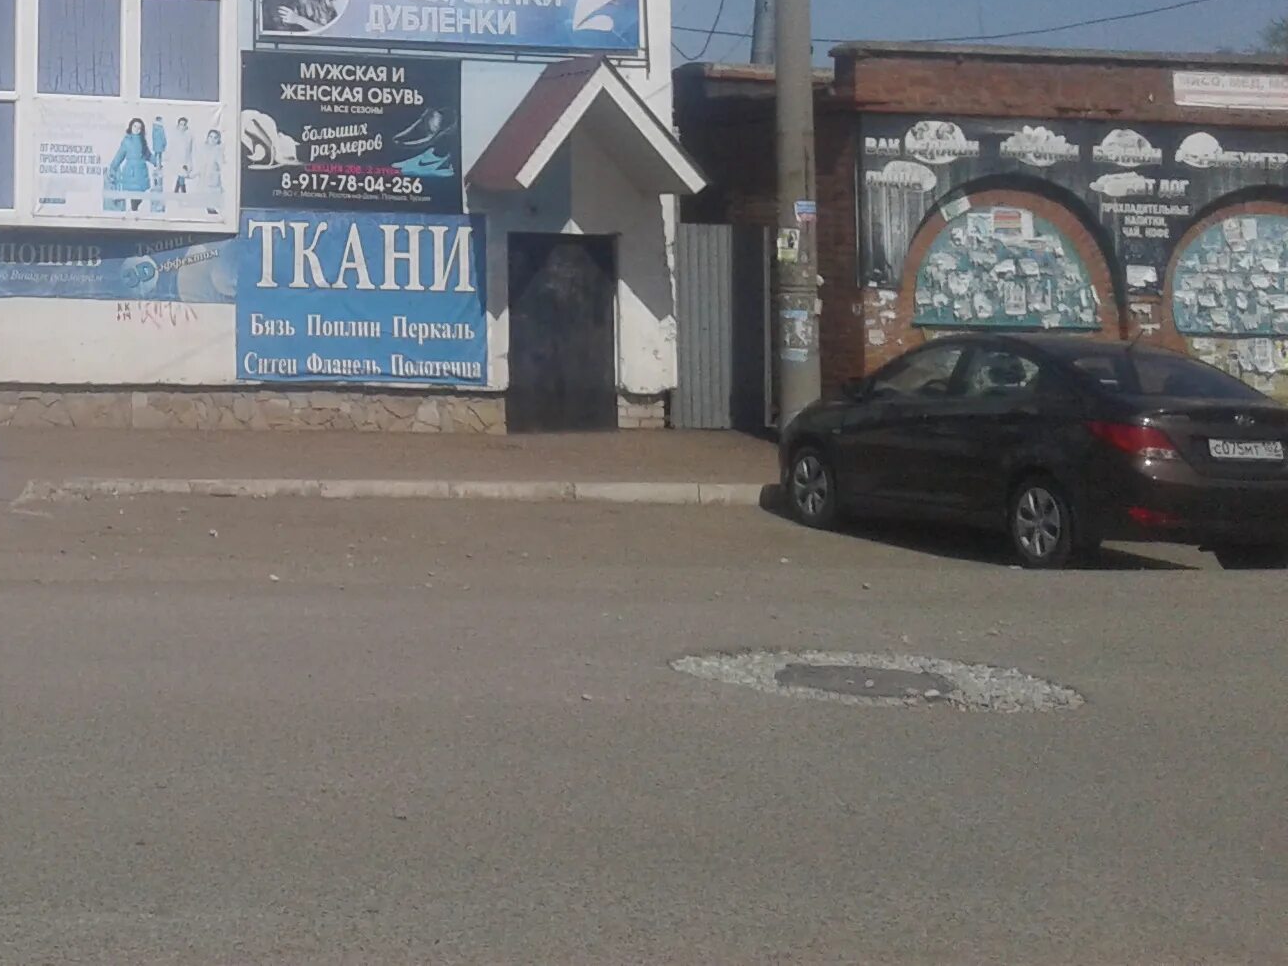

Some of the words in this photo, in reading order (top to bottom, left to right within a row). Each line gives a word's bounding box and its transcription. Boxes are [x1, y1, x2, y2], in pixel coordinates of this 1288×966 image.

[366, 4, 517, 35] ДУБЛЕНКИ
[300, 63, 387, 82] МУЖСКАЯ
[391, 67, 405, 83] И
[280, 84, 362, 103] ЖЕНСКАЯ
[368, 87, 424, 105] ОБУВЬ
[320, 104, 332, 113] НА
[334, 105, 349, 113] ВСЕ
[351, 105, 383, 115] СЕЗОНЫ
[302, 122, 368, 142] больших
[310, 135, 382, 161] размеров
[281, 172, 423, 194] 8-917-78-04-256
[0, 242, 102, 266] ПОШИВ
[248, 219, 476, 292] ТКАНИ
[250, 313, 296, 336] Бязь
[307, 314, 381, 338] Поплин
[392, 315, 475, 345] Перкаль
[243, 352, 297, 376] Ситец
[306, 353, 382, 376] Фланель
[391, 353, 482, 379] Полотенца
